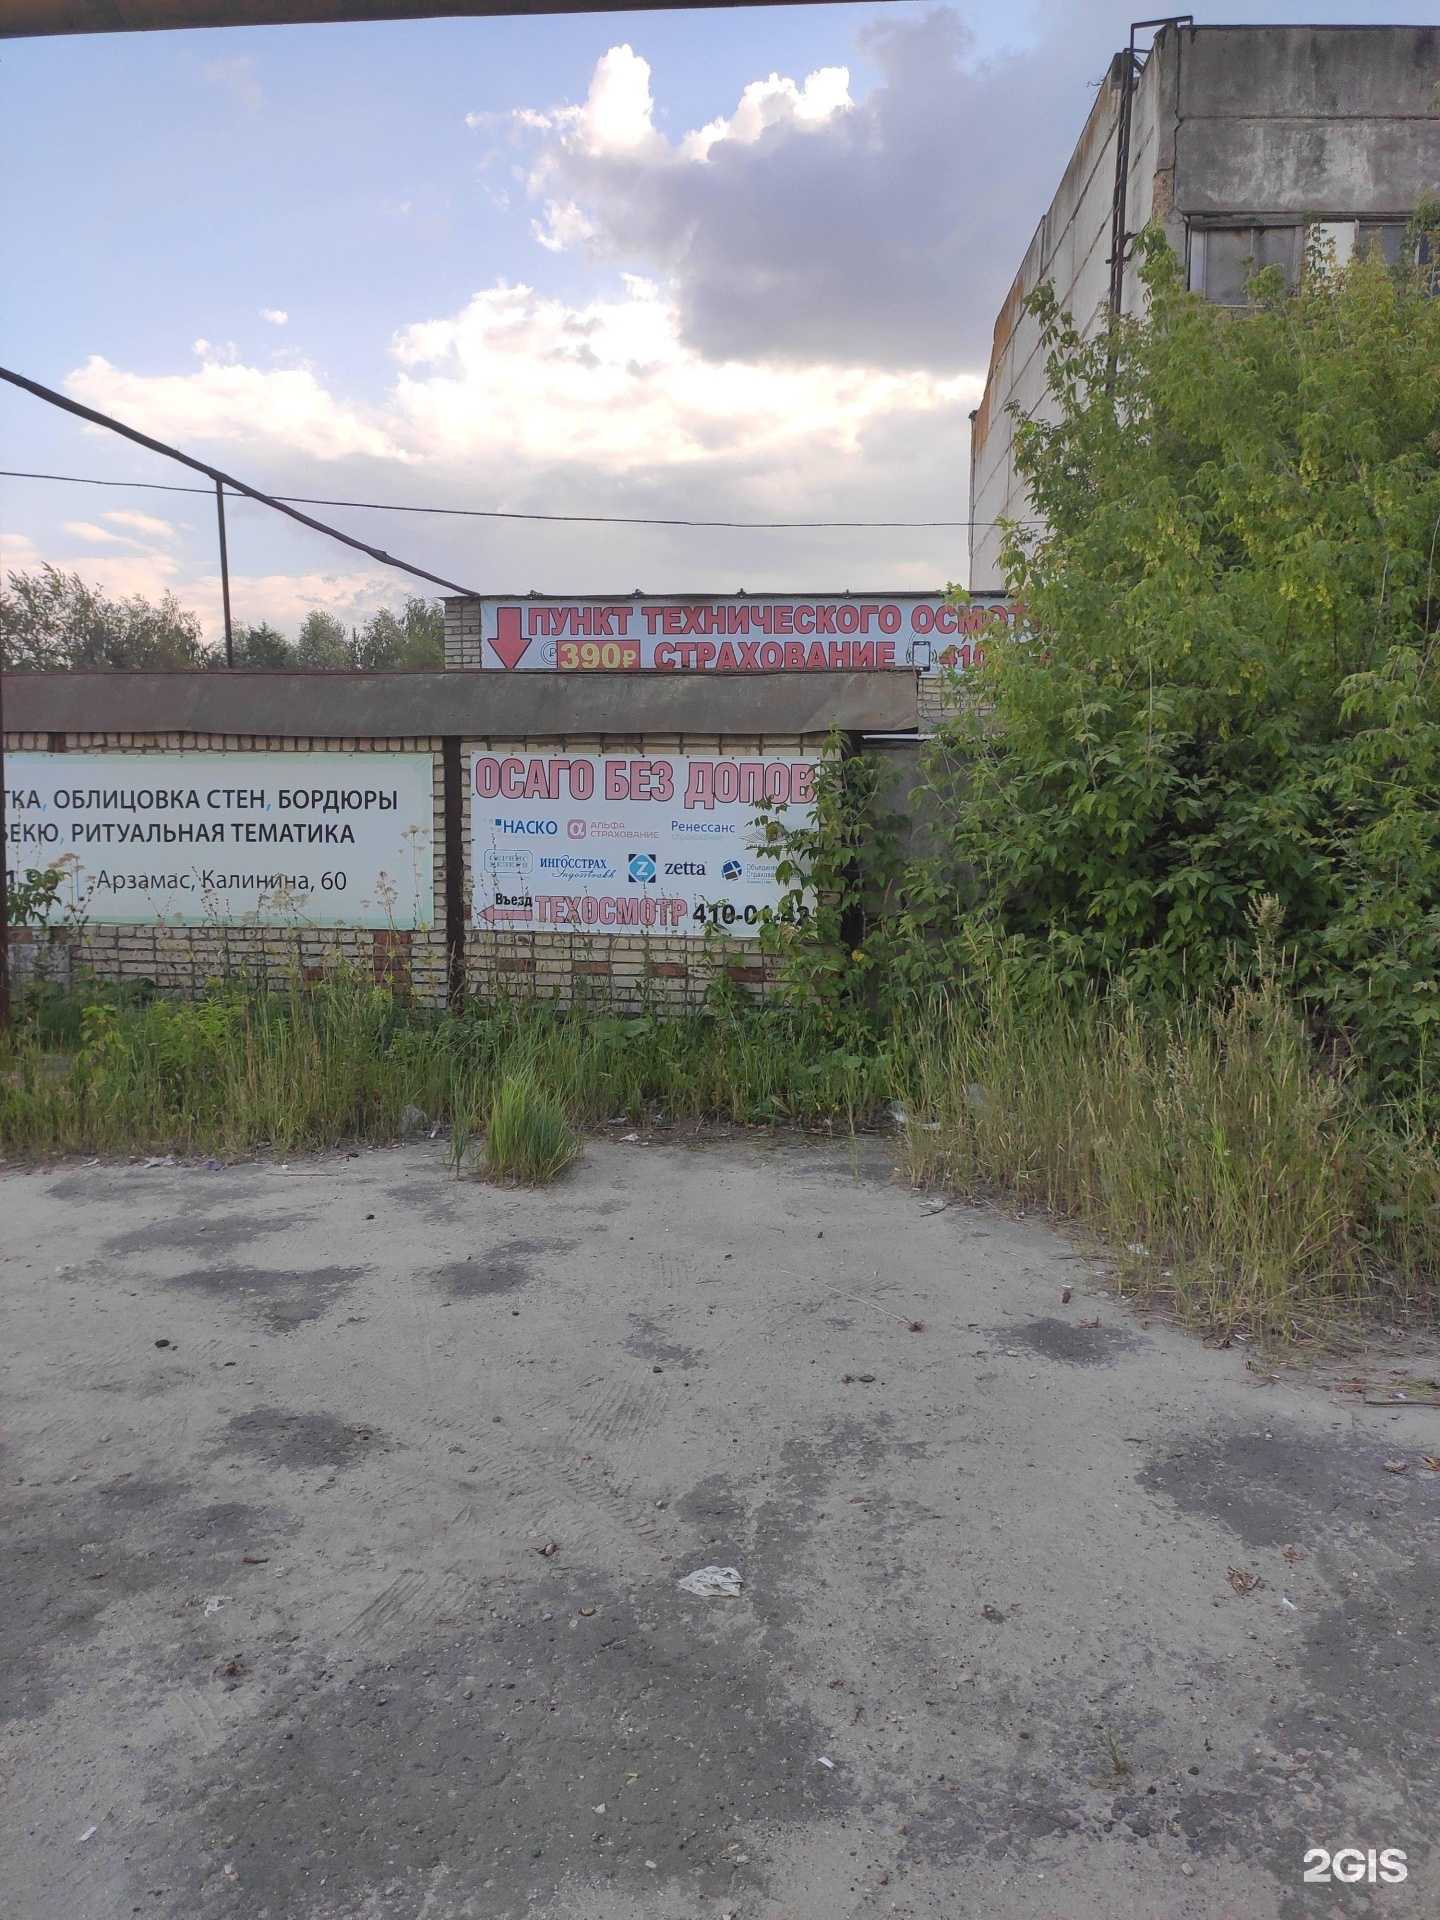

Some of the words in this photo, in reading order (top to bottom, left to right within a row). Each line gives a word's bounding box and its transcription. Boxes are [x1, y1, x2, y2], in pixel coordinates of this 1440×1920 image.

[528, 607, 633, 635] ПУНКТ
[641, 605, 902, 634] ТЕХНИЧЕСКОГО
[654, 641, 896, 670] СТРАХОВАНИЕ
[476, 758, 594, 800] ОСАГО
[605, 760, 674, 801] БЕЗ
[684, 762, 818, 809] ДОПОВ
[54, 790, 200, 813] ОБЛИЦОВКА
[207, 789, 272, 811] СТЕН,
[278, 790, 398, 813] БОРДЮРЫ
[72, 823, 225, 843] РИТУАЛЬНАЯ
[231, 824, 356, 843] ТЕМАТИКА
[503, 820, 558, 835] НАСКО
[671, 820, 736, 833] Ренессанс
[540, 855, 607, 869] ИНГОССТРАХ
[664, 861, 706, 876] zetta
[96, 870, 195, 893] Арзамас,
[202, 870, 314, 892] Калинина,
[321, 872, 347, 890] 60
[495, 893, 533, 907] Въезд
[535, 896, 688, 926] ТЕХОСМОТР
